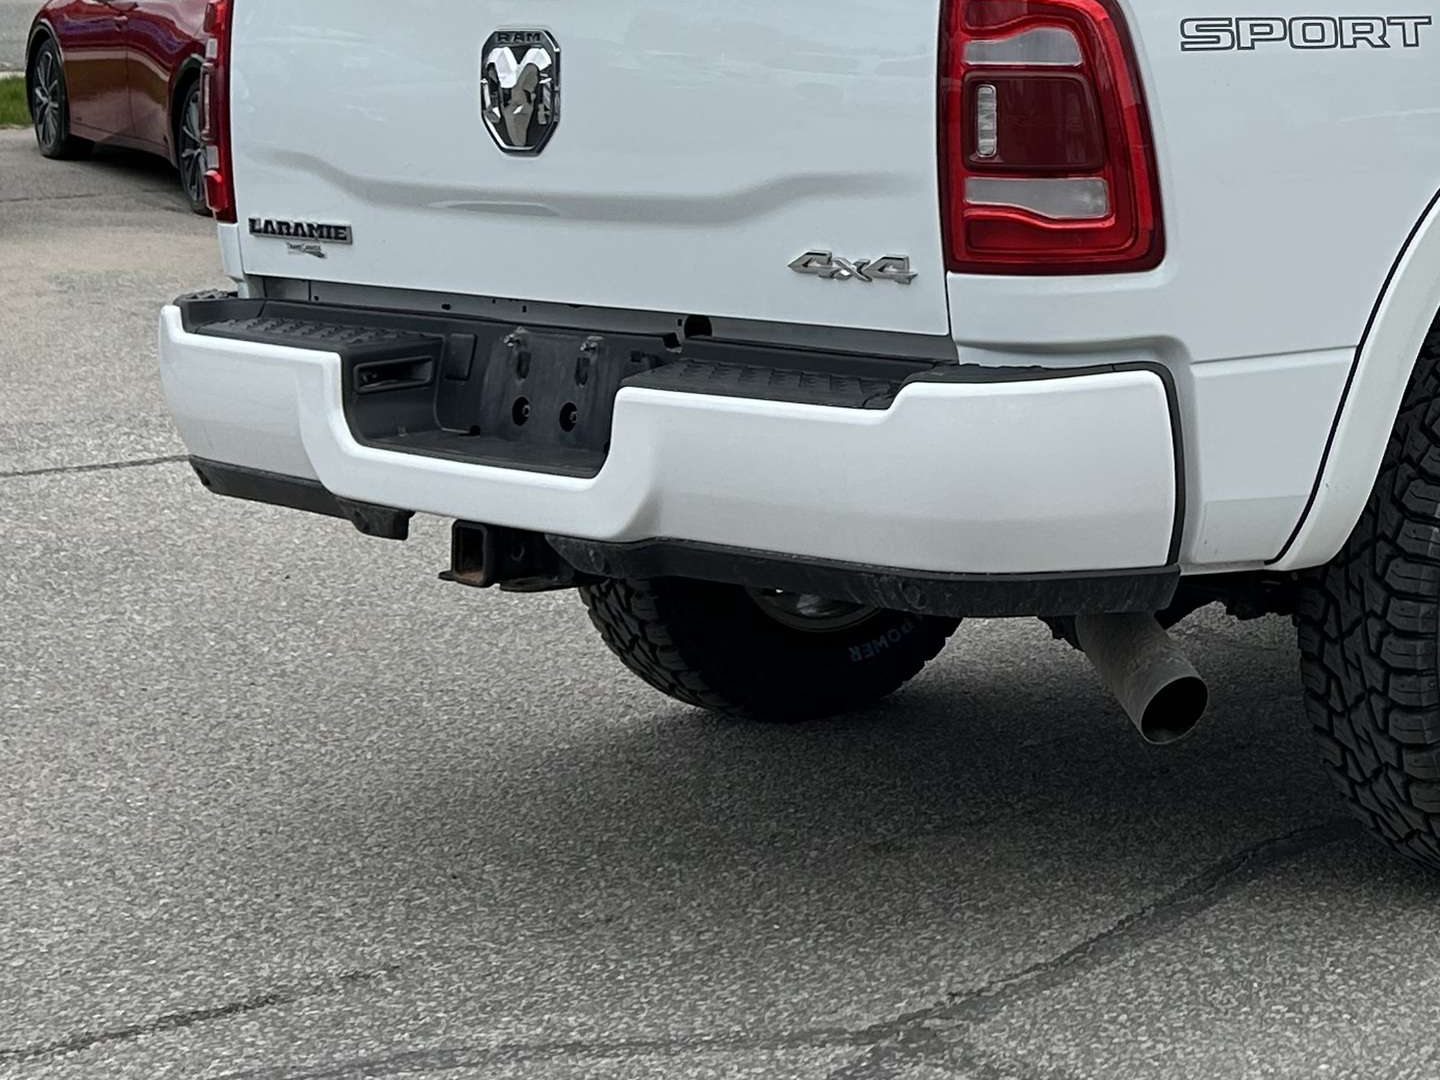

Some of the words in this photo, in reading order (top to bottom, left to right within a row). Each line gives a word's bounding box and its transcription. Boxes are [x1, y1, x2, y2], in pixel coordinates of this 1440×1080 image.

[497, 32, 541, 43] RAM
[1180, 16, 1431, 51] SPORT
[248, 218, 352, 243] LARAMIE
